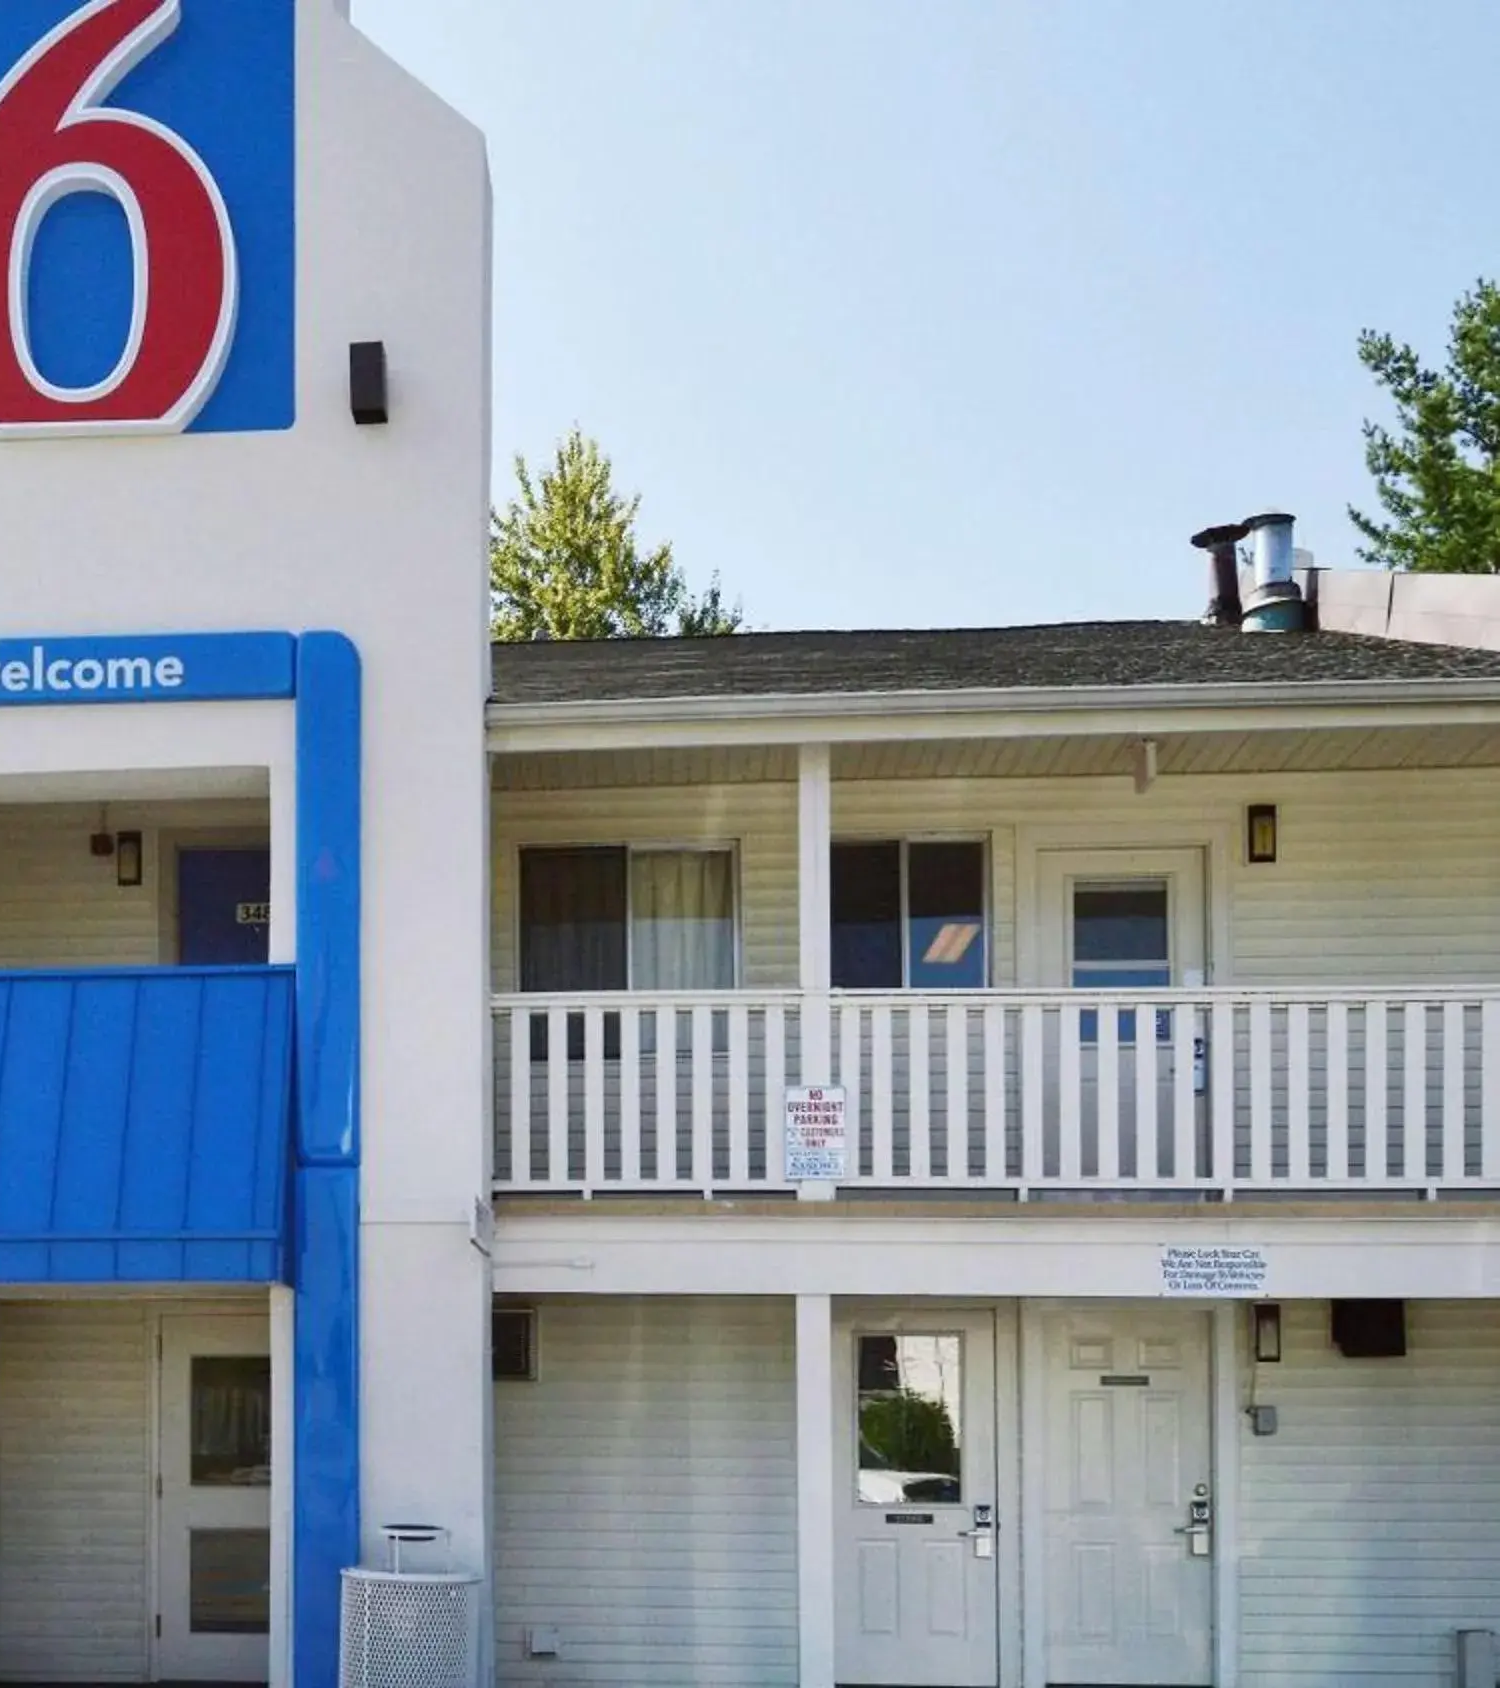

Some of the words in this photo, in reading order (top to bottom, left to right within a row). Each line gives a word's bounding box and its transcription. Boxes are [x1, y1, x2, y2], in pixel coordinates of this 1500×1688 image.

[808, 1090, 823, 1101] NO
[787, 1101, 843, 1113] OVERNIGHT
[794, 1114, 838, 1125] PARKING
